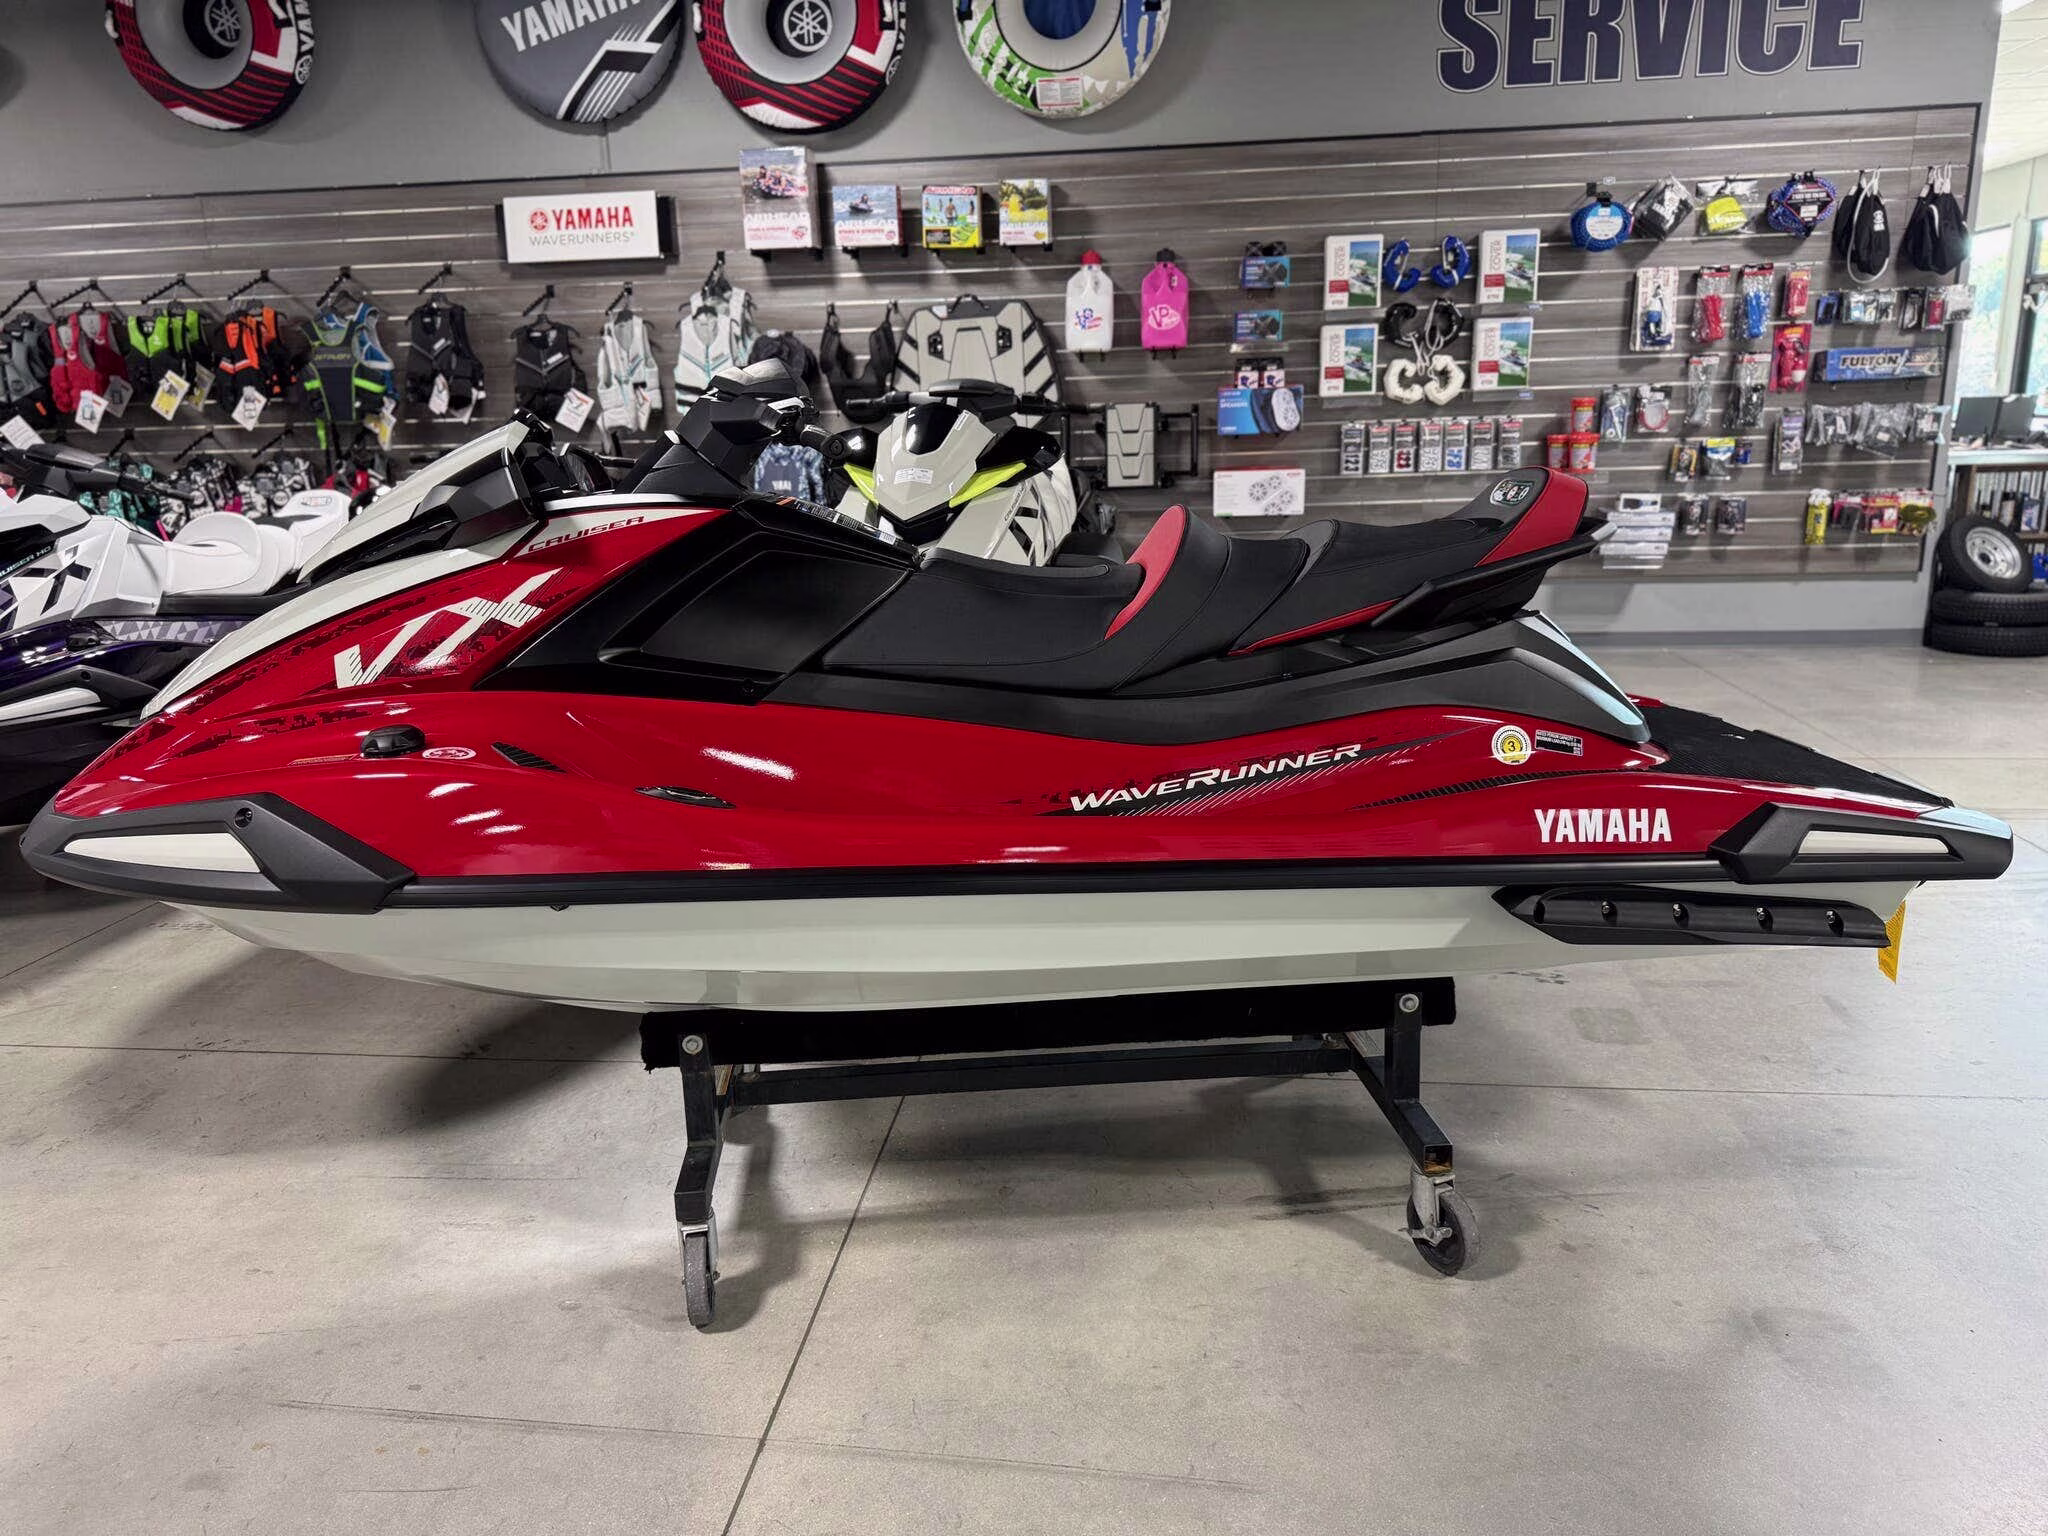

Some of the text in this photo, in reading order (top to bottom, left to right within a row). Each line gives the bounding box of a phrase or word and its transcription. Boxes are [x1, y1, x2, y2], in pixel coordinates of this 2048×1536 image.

[1436, 0, 1864, 95] SERVICE
[552, 205, 635, 231] YAMAHA
[1840, 354, 1900, 368] FULTON
[528, 516, 645, 553] CRUISER
[333, 566, 565, 689] VX
[1507, 740, 1516, 752] 3
[1534, 808, 1672, 843] YAMAHA
